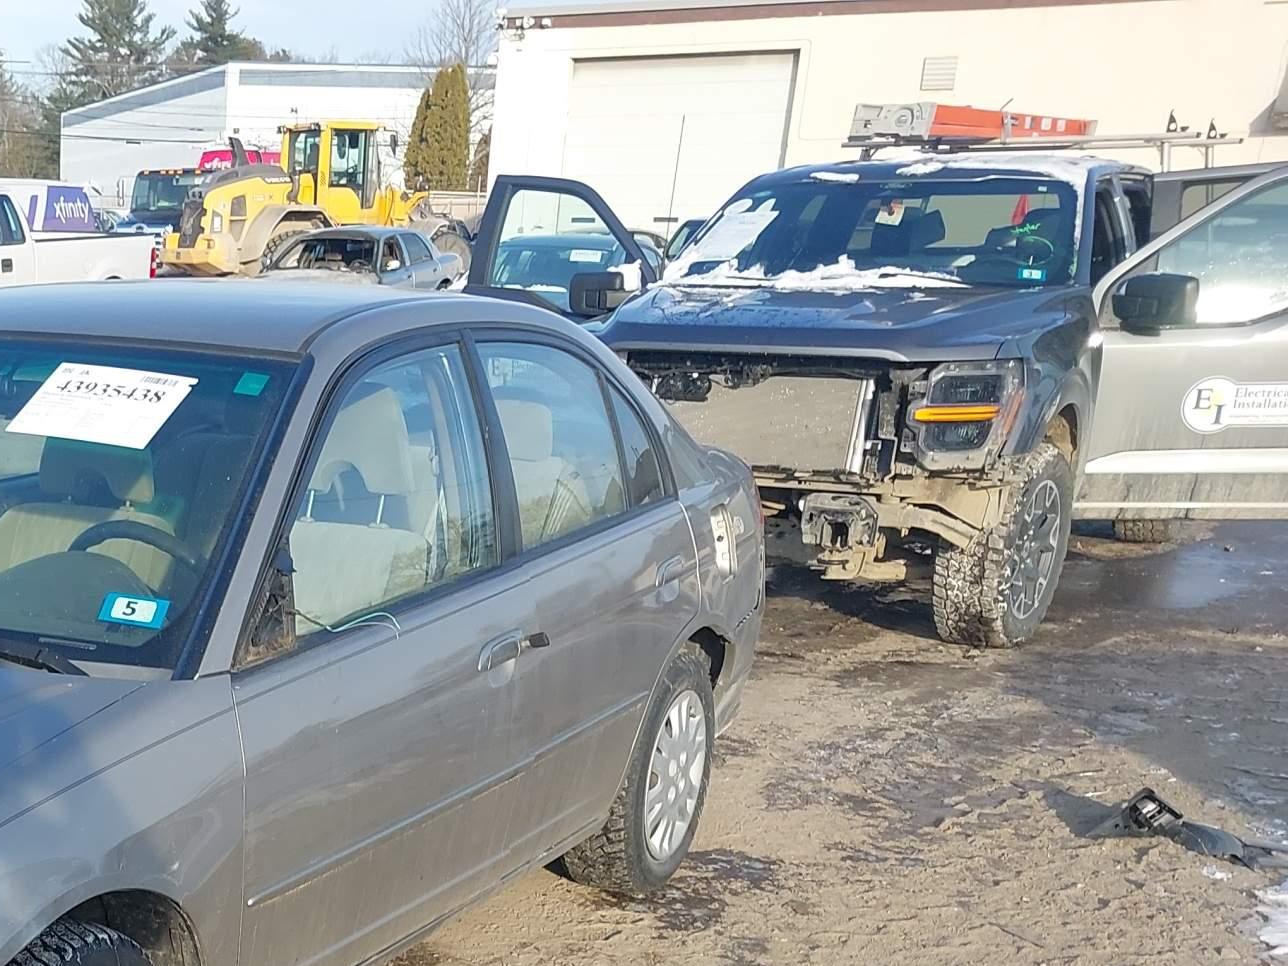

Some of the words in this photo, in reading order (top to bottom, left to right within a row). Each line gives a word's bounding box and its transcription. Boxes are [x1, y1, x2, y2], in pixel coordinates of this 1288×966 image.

[53, 195, 89, 224] xfinity
[56, 379, 166, 404] 43935438
[122, 600, 138, 616] 5
